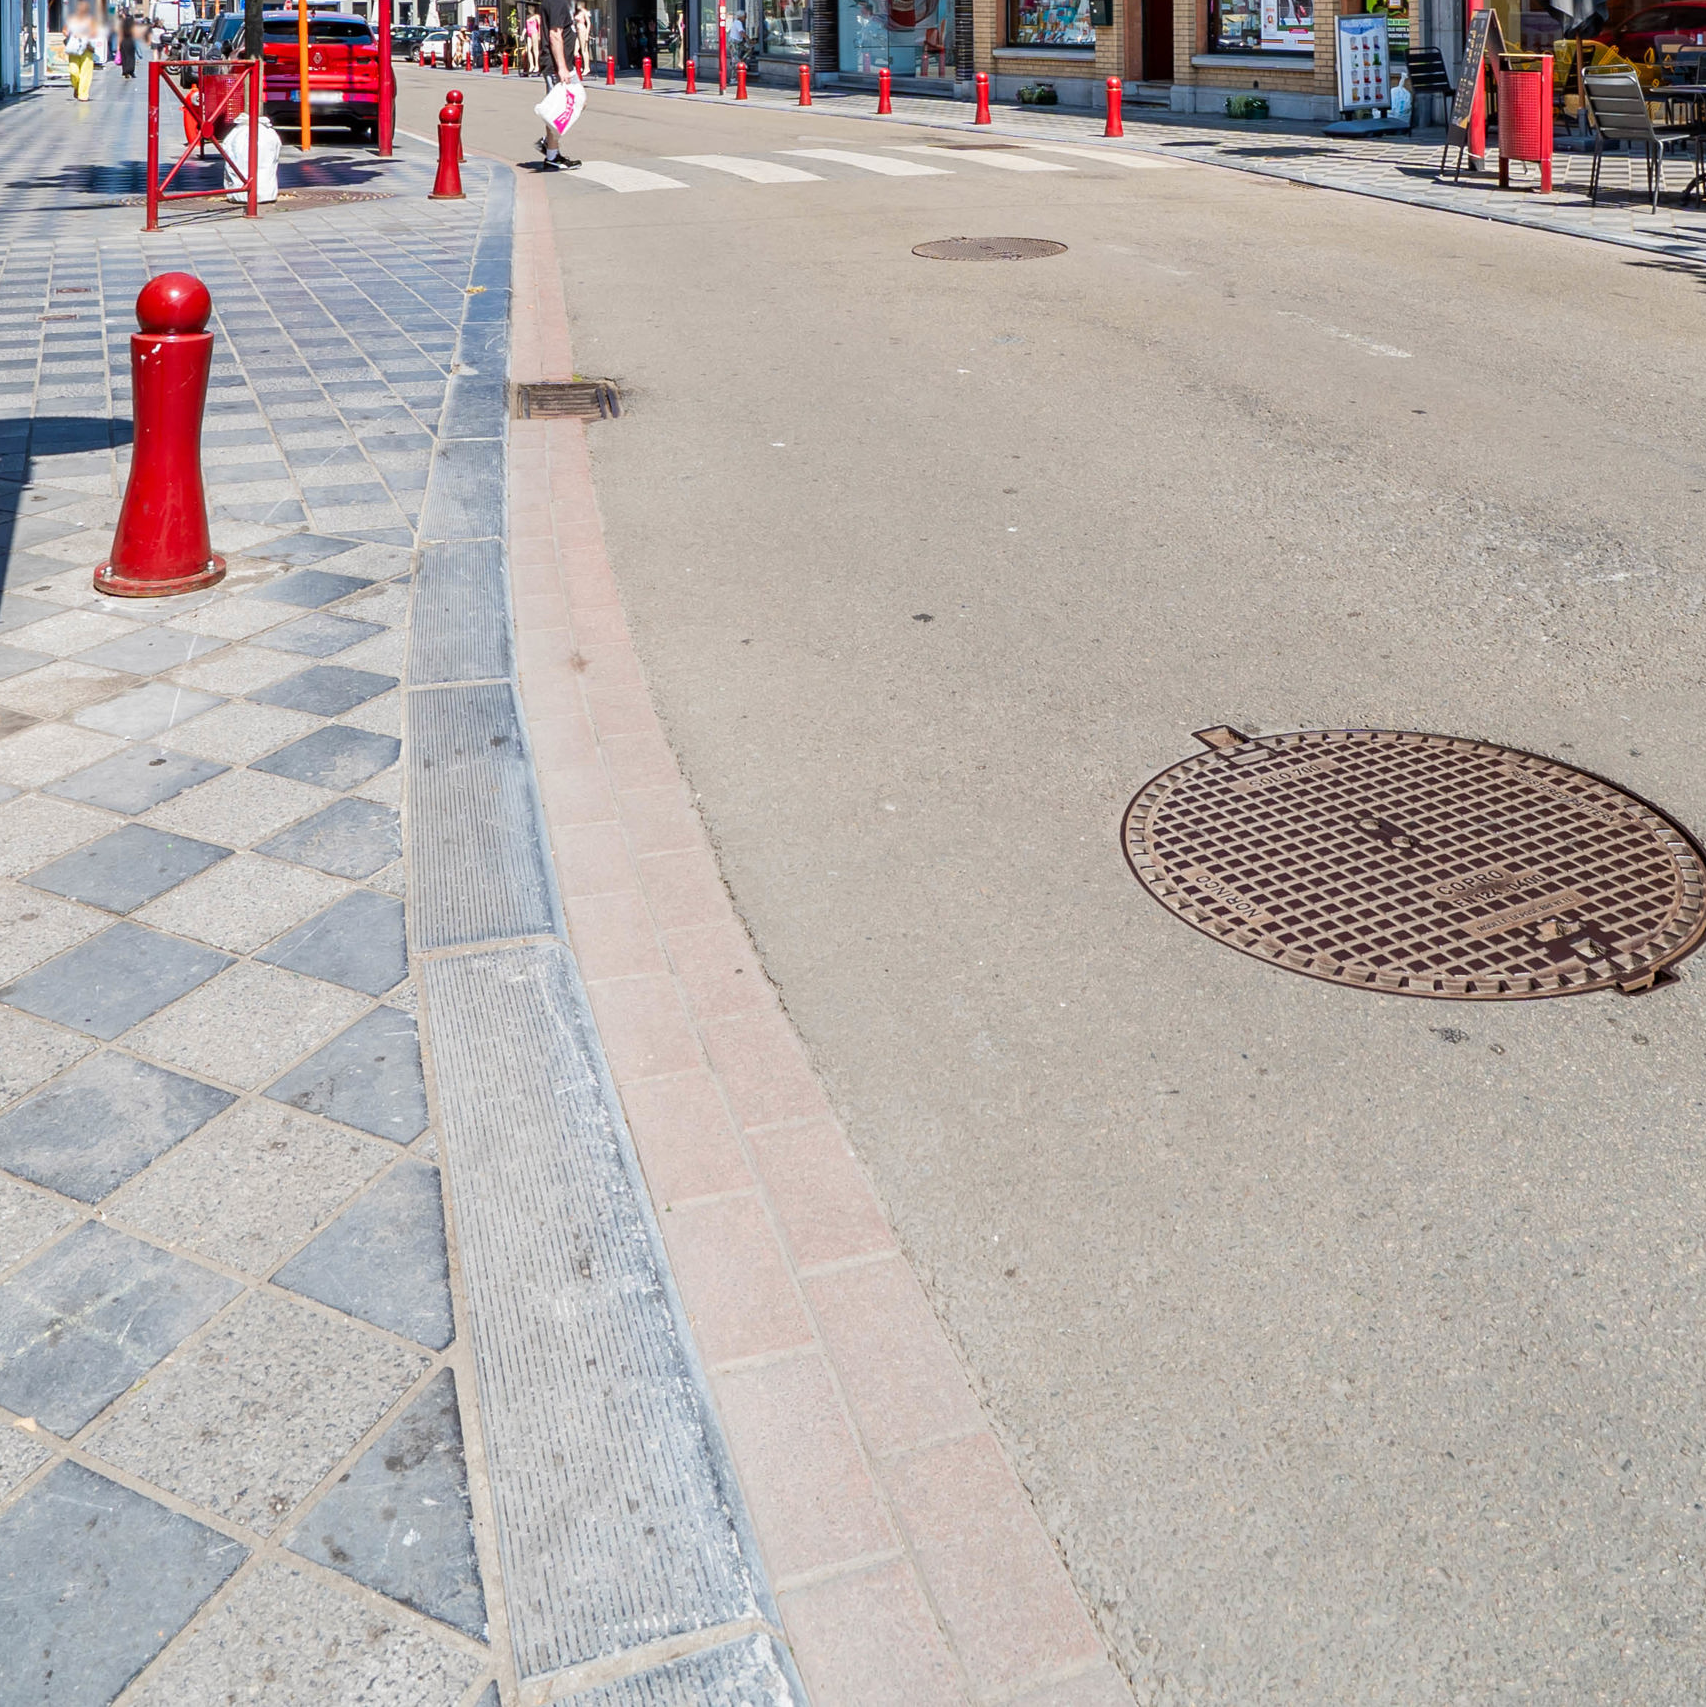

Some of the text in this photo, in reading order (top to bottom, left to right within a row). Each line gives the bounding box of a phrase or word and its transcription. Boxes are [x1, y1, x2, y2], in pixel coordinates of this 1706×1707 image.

[1249, 764, 1322, 789] SOLO 700
[1510, 770, 1617, 823] REGISTERED PATTERN
[1436, 869, 1504, 896] COPRO
[1195, 874, 1263, 920] NORINCO
[1454, 894, 1480, 909] EN
